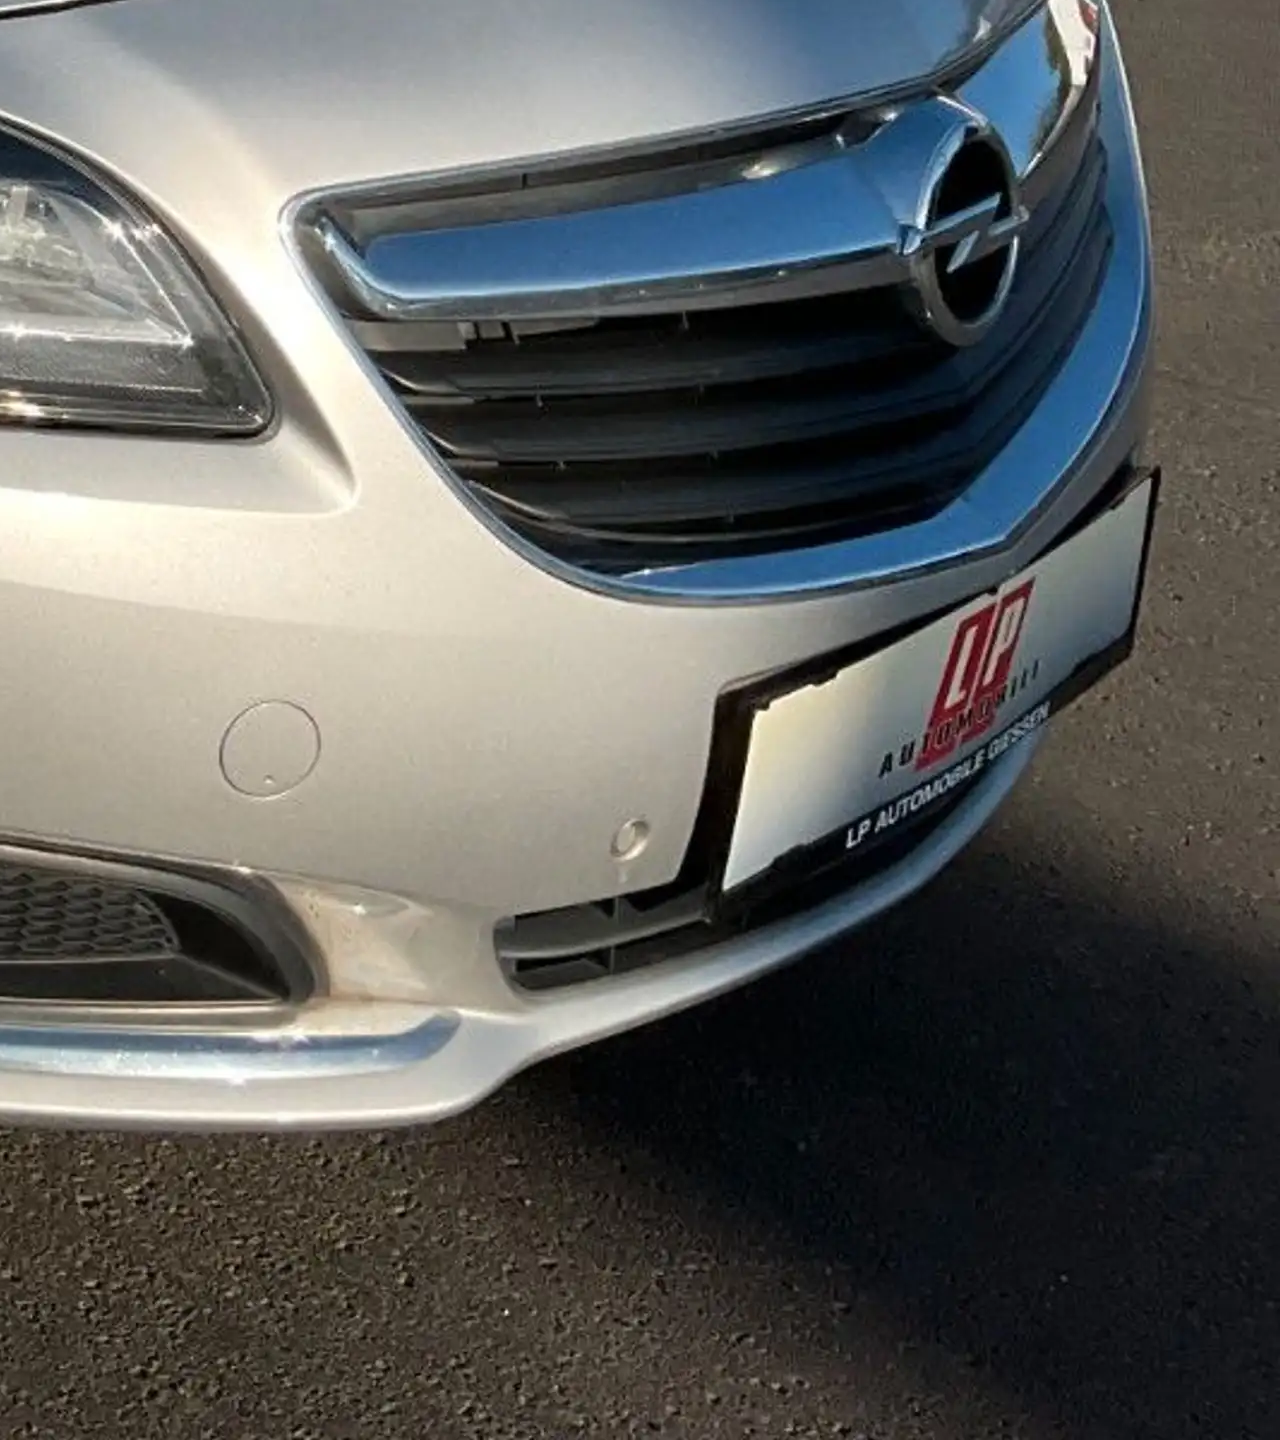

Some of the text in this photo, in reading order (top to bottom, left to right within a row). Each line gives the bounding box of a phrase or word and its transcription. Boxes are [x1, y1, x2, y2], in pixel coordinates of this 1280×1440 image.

[943, 596, 1025, 710] LP
[845, 817, 872, 849] LP
[875, 747, 985, 831] AUTOMOBILE
